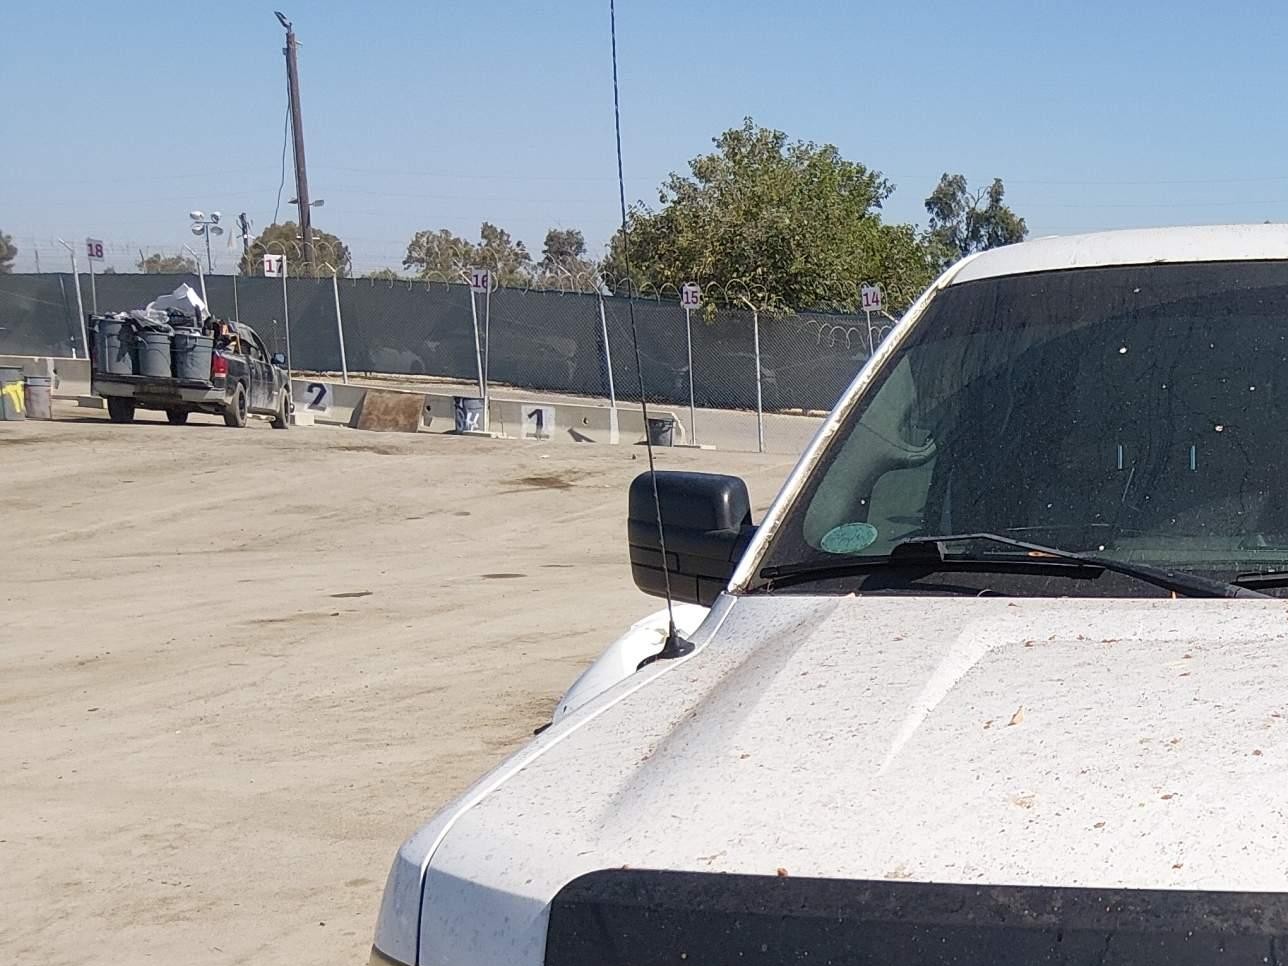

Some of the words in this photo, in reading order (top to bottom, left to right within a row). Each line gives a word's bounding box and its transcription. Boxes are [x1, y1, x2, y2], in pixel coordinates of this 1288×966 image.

[87, 243, 104, 258] 18
[266, 258, 284, 273] 17
[684, 290, 699, 305] 15
[862, 292, 880, 307] 14
[307, 382, 328, 412] 2
[526, 408, 550, 439] 1
